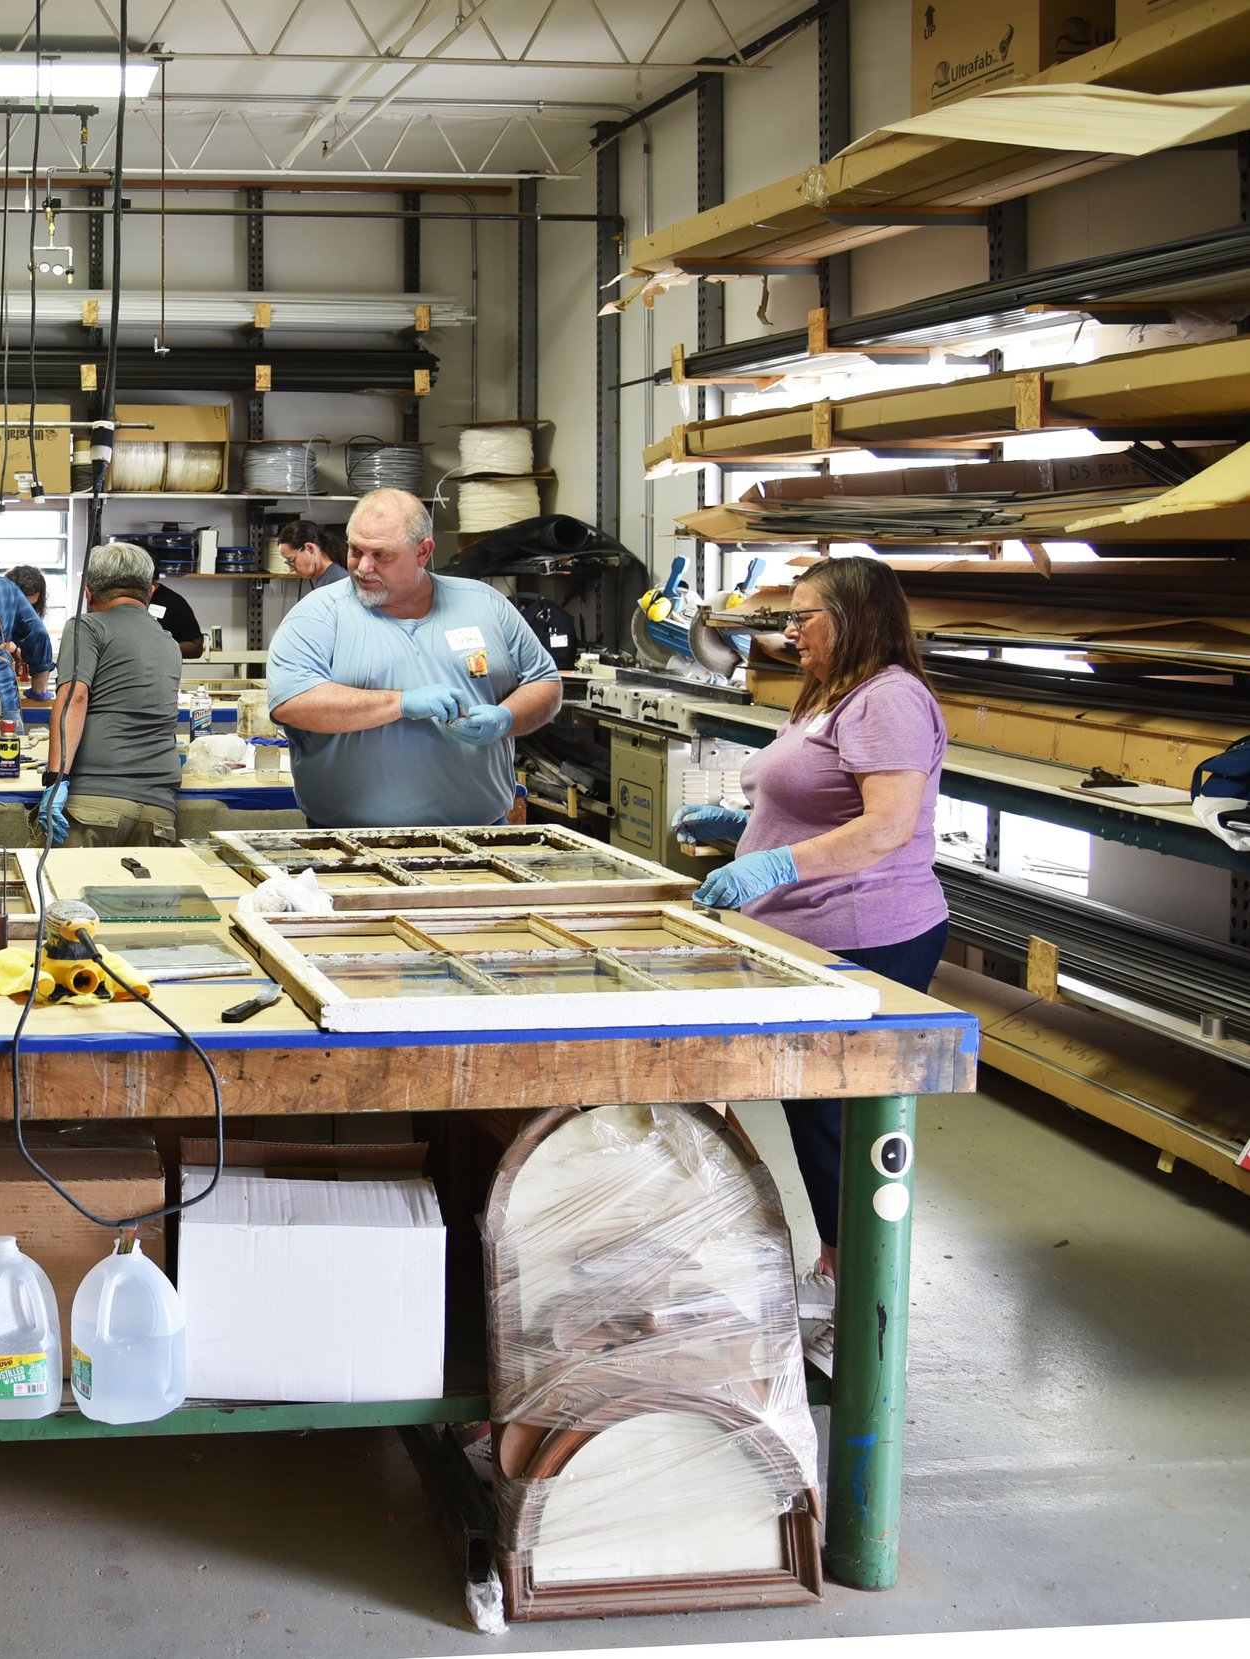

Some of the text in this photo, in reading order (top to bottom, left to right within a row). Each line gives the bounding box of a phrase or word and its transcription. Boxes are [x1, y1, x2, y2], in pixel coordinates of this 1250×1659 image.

[923, 25, 936, 40] UP
[951, 51, 993, 82] Ultrafab
[0, 743, 18, 751] WD-40
[2, 1374, 26, 1385] WATER
